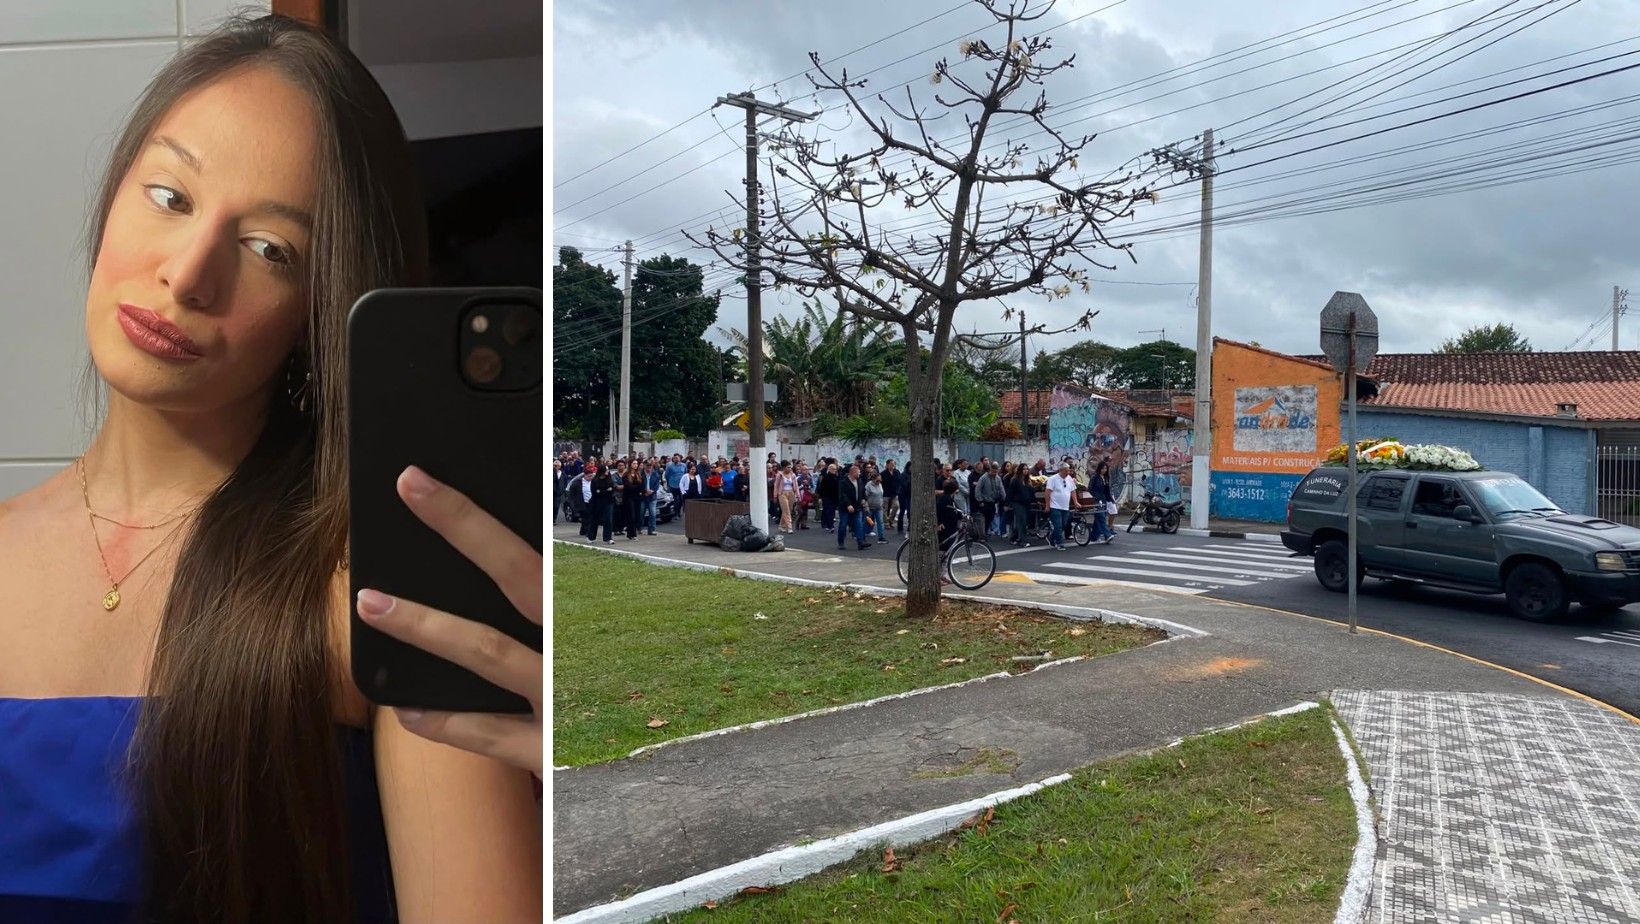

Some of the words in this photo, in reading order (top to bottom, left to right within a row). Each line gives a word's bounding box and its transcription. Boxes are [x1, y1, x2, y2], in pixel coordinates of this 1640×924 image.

[1239, 411, 1311, 429] andrade
[1222, 456, 1262, 466] MATERIAIS
[1263, 457, 1271, 467] P/
[1273, 457, 1324, 468] CONSTRUÇÃ
[1228, 487, 1264, 500] 3643-1512
